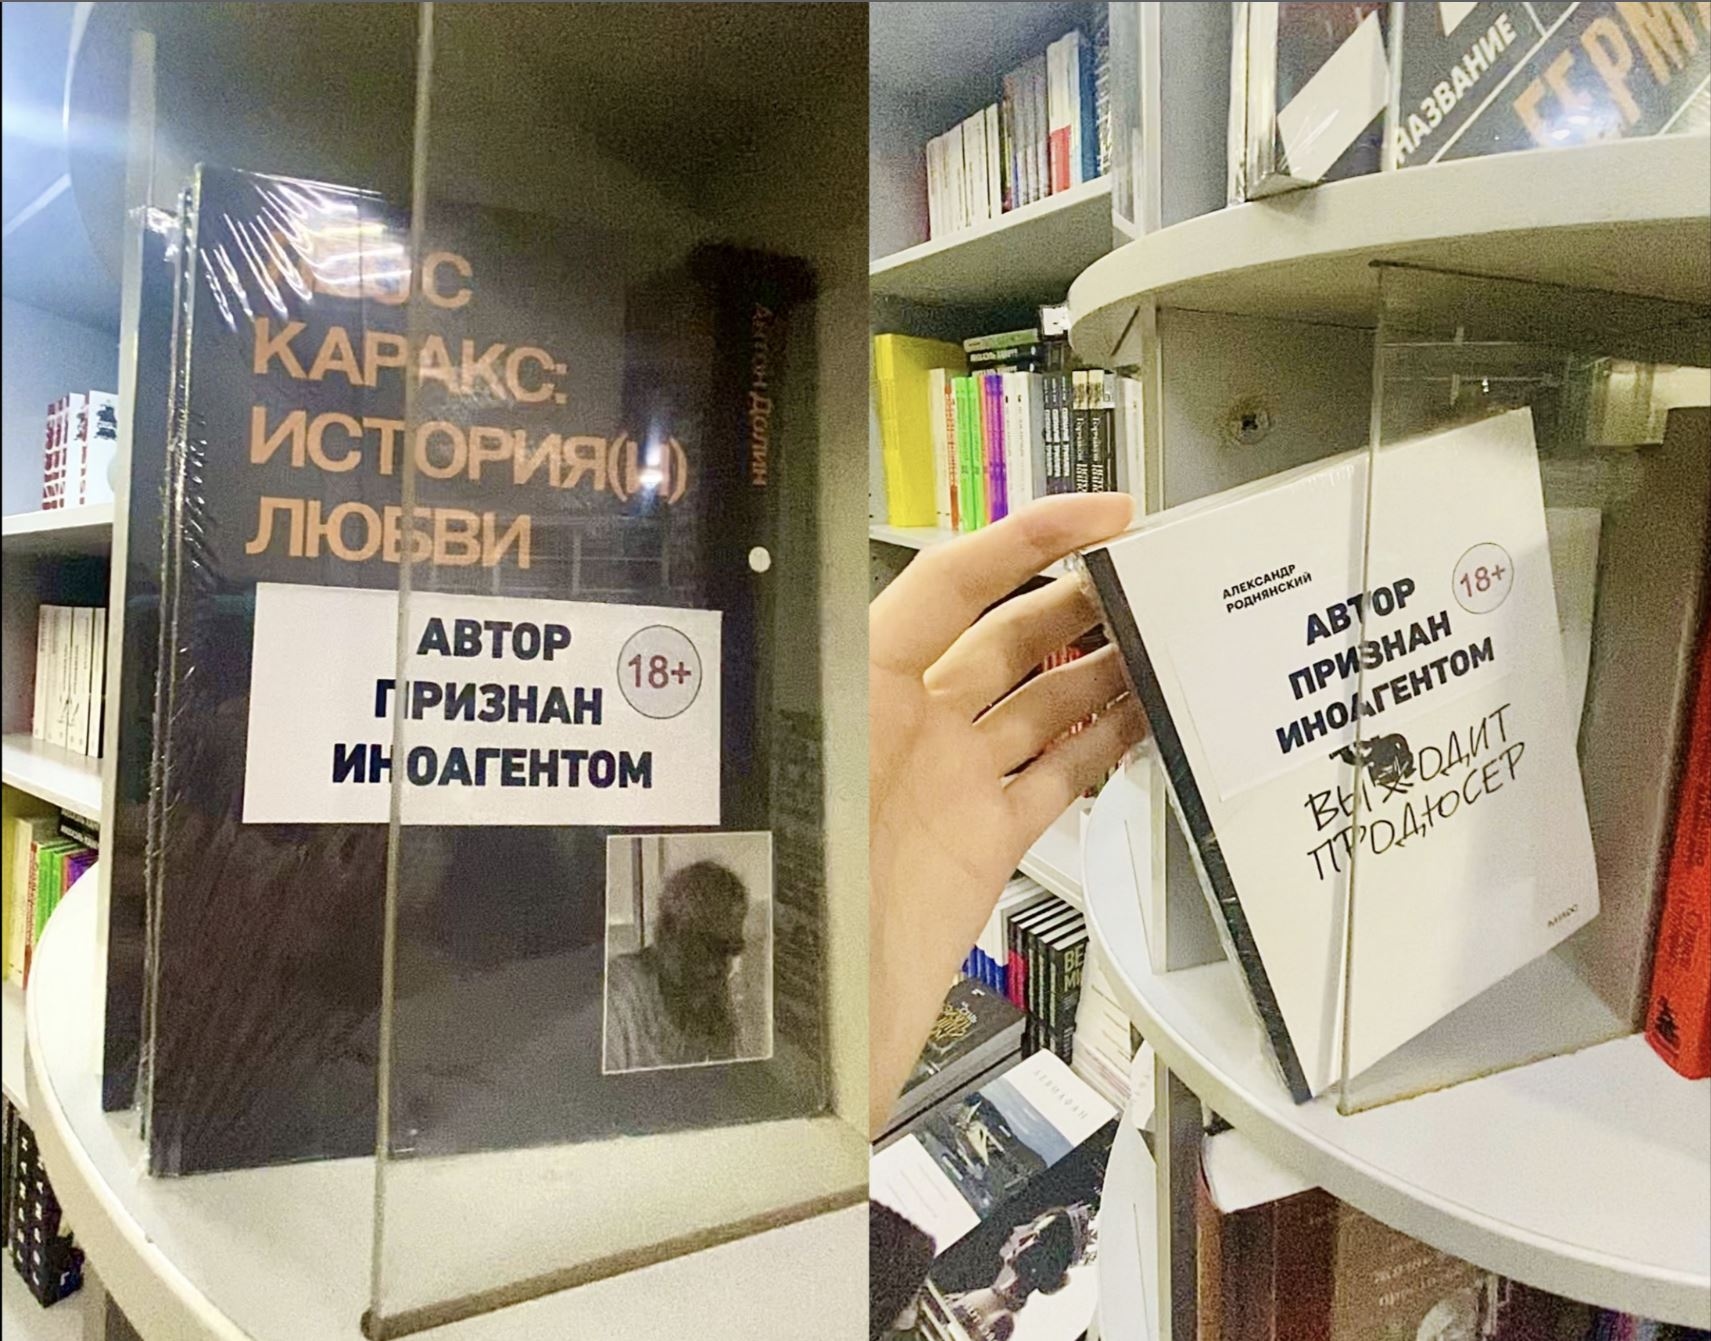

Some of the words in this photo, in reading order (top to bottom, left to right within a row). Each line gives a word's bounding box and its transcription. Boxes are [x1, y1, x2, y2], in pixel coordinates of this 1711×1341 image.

[1394, 12, 1517, 165] НАЗВАНИЕ
[1513, 2, 1710, 148] ГЕРМ
[252, 316, 567, 405] КАРАКС:
[750, 390, 772, 487] Долин
[245, 494, 532, 570] ЛЮБВИ
[1222, 563, 1296, 600] АЛЕКСАНДР
[1226, 571, 1313, 613] РОДНЯНСКИЙ
[1306, 577, 1416, 646] АВТОР
[1460, 563, 1506, 598] 18+
[416, 617, 572, 661] АВТОР
[627, 654, 692, 690] 18+
[1288, 610, 1452, 700] ПРИЗНАН
[374, 678, 603, 725] ПРИЗНАН
[1275, 636, 1495, 754] ИНОАГЕНТОМ
[332, 743, 653, 789] ИНОАГЕНТОМ
[1304, 703, 1511, 832] ВЫХОДИТ
[1307, 741, 1525, 880] ПРОДЮСЕР
